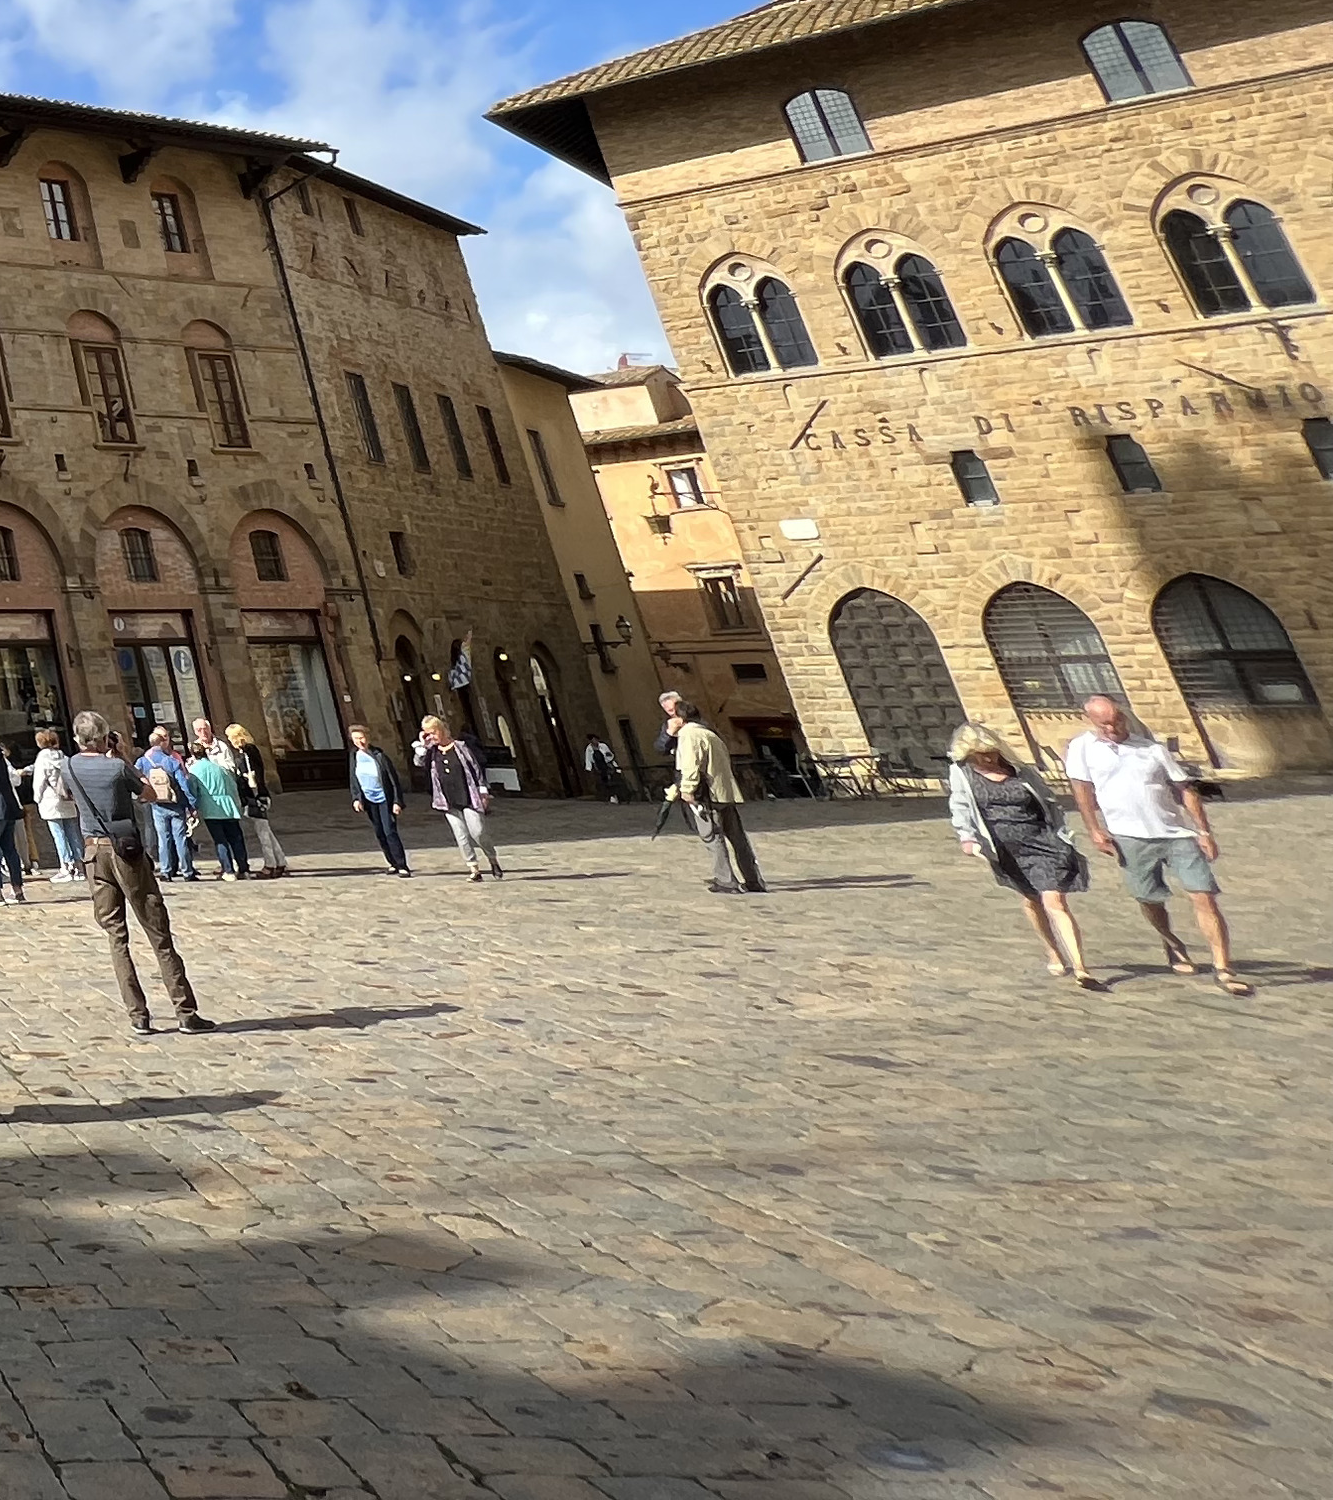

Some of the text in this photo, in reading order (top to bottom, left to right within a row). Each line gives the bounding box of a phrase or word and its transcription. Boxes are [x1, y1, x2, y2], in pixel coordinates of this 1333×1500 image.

[804, 382, 1325, 450] CASSA DI RISPARMIO
